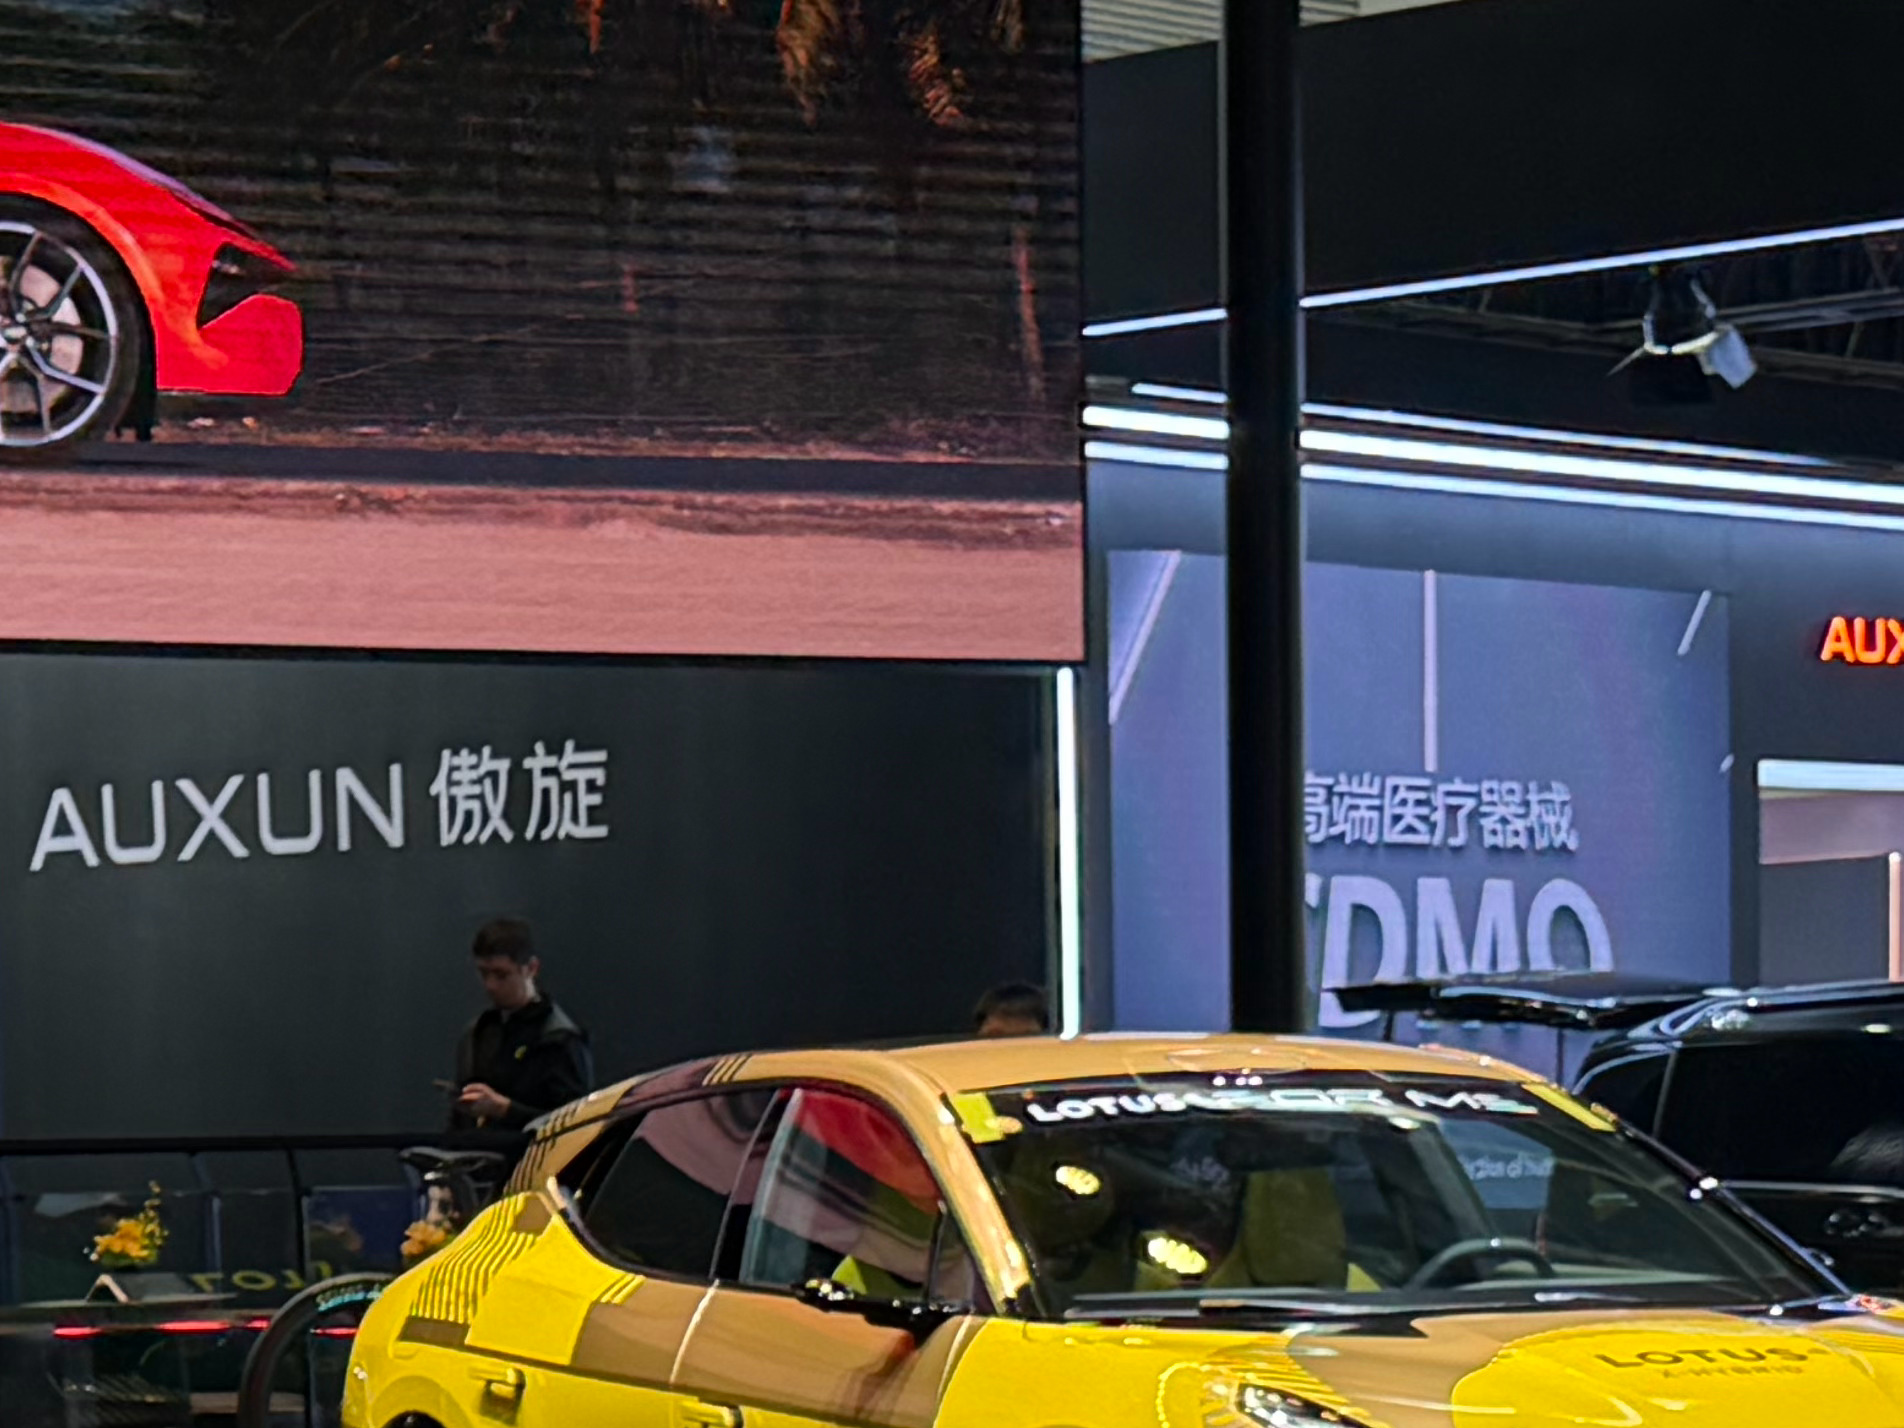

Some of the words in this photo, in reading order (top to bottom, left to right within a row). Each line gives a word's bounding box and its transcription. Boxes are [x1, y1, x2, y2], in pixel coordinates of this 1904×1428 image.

[29, 763, 405, 872] AUXUN
[429, 738, 610, 847] 傲旋
[1304, 771, 1580, 852] 高端医疗器械
[1304, 872, 1614, 1028] DMO
[1594, 1348, 1809, 1368] LOTUS
